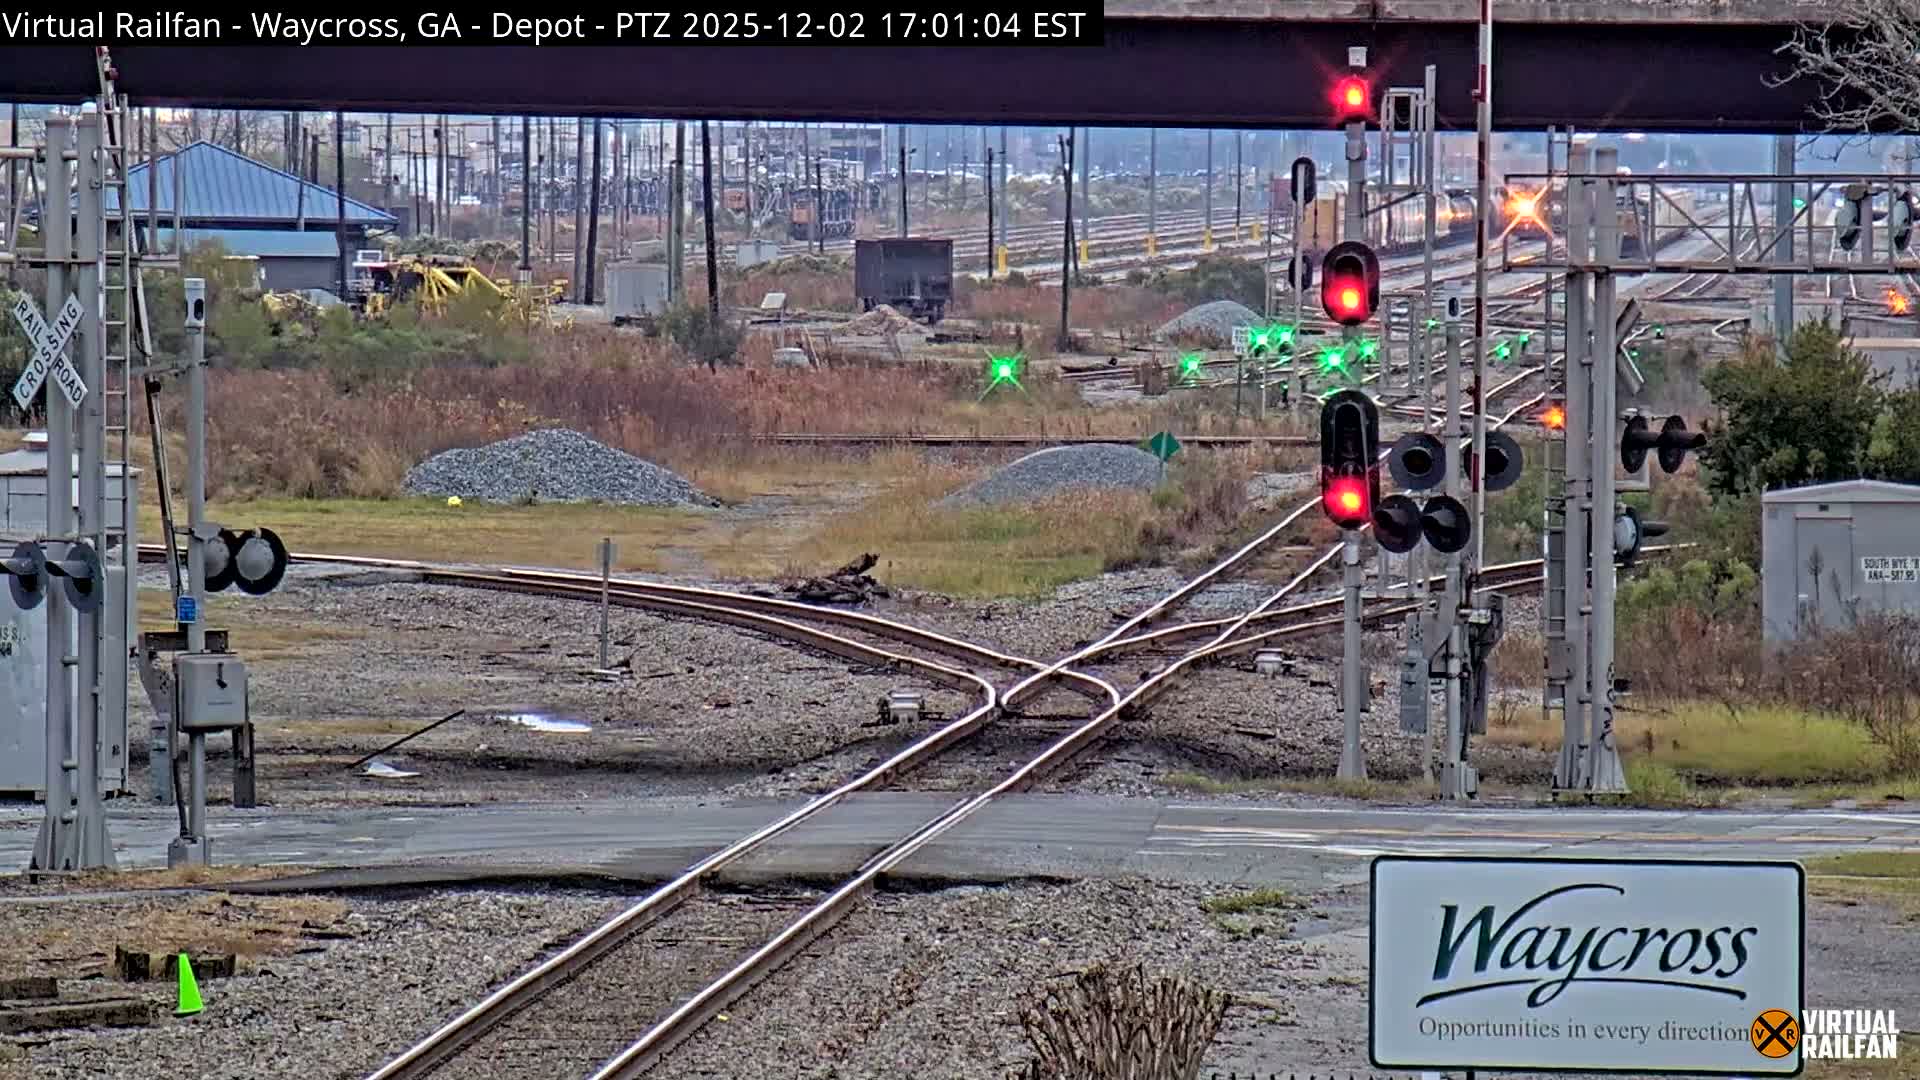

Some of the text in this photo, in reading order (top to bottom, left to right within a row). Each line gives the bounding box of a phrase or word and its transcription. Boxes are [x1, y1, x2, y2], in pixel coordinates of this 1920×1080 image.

[17, 300, 83, 402] RAIL ROAD
[19, 303, 78, 399] CROSSING
[1431, 883, 1758, 1008] Waycross
[1418, 1016, 1751, 1046] Opportunities in every direction
